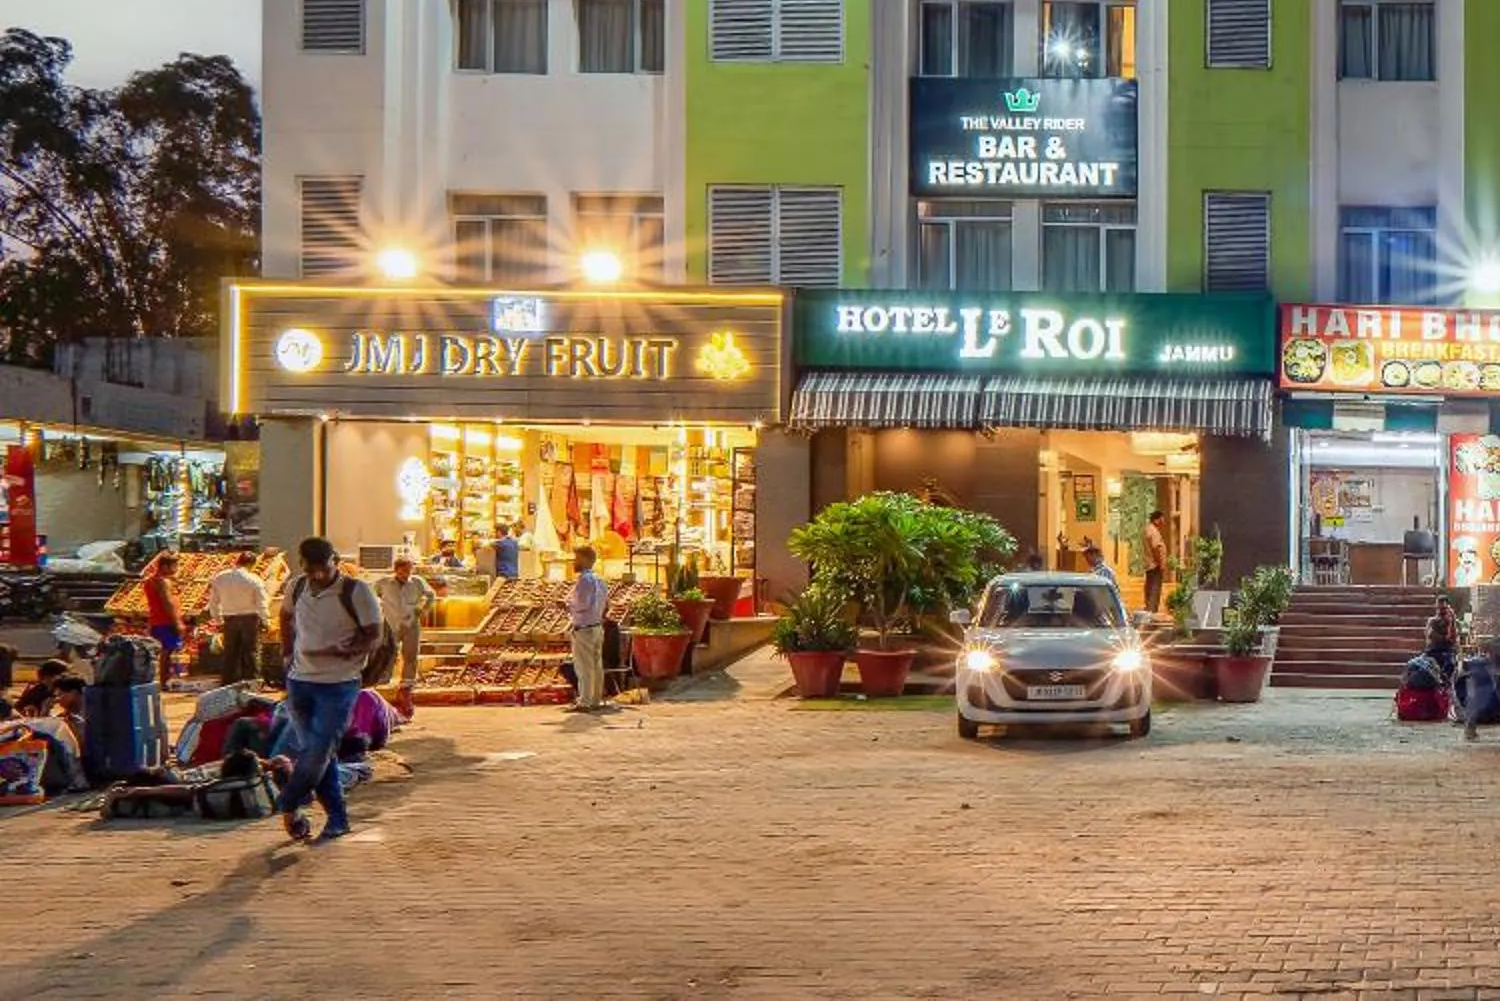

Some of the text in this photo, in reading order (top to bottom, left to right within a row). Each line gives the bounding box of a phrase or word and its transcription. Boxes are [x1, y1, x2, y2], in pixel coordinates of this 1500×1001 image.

[961, 117, 1085, 130] THE VALLEY RIDER
[978, 136, 1066, 159] BAR &
[928, 161, 1119, 185] RESTAURANT
[836, 306, 957, 333] HOTEL
[1291, 307, 1401, 338] HARI
[345, 332, 678, 379] JMJ DRY FRUIT
[1160, 345, 1233, 362] JAMMU
